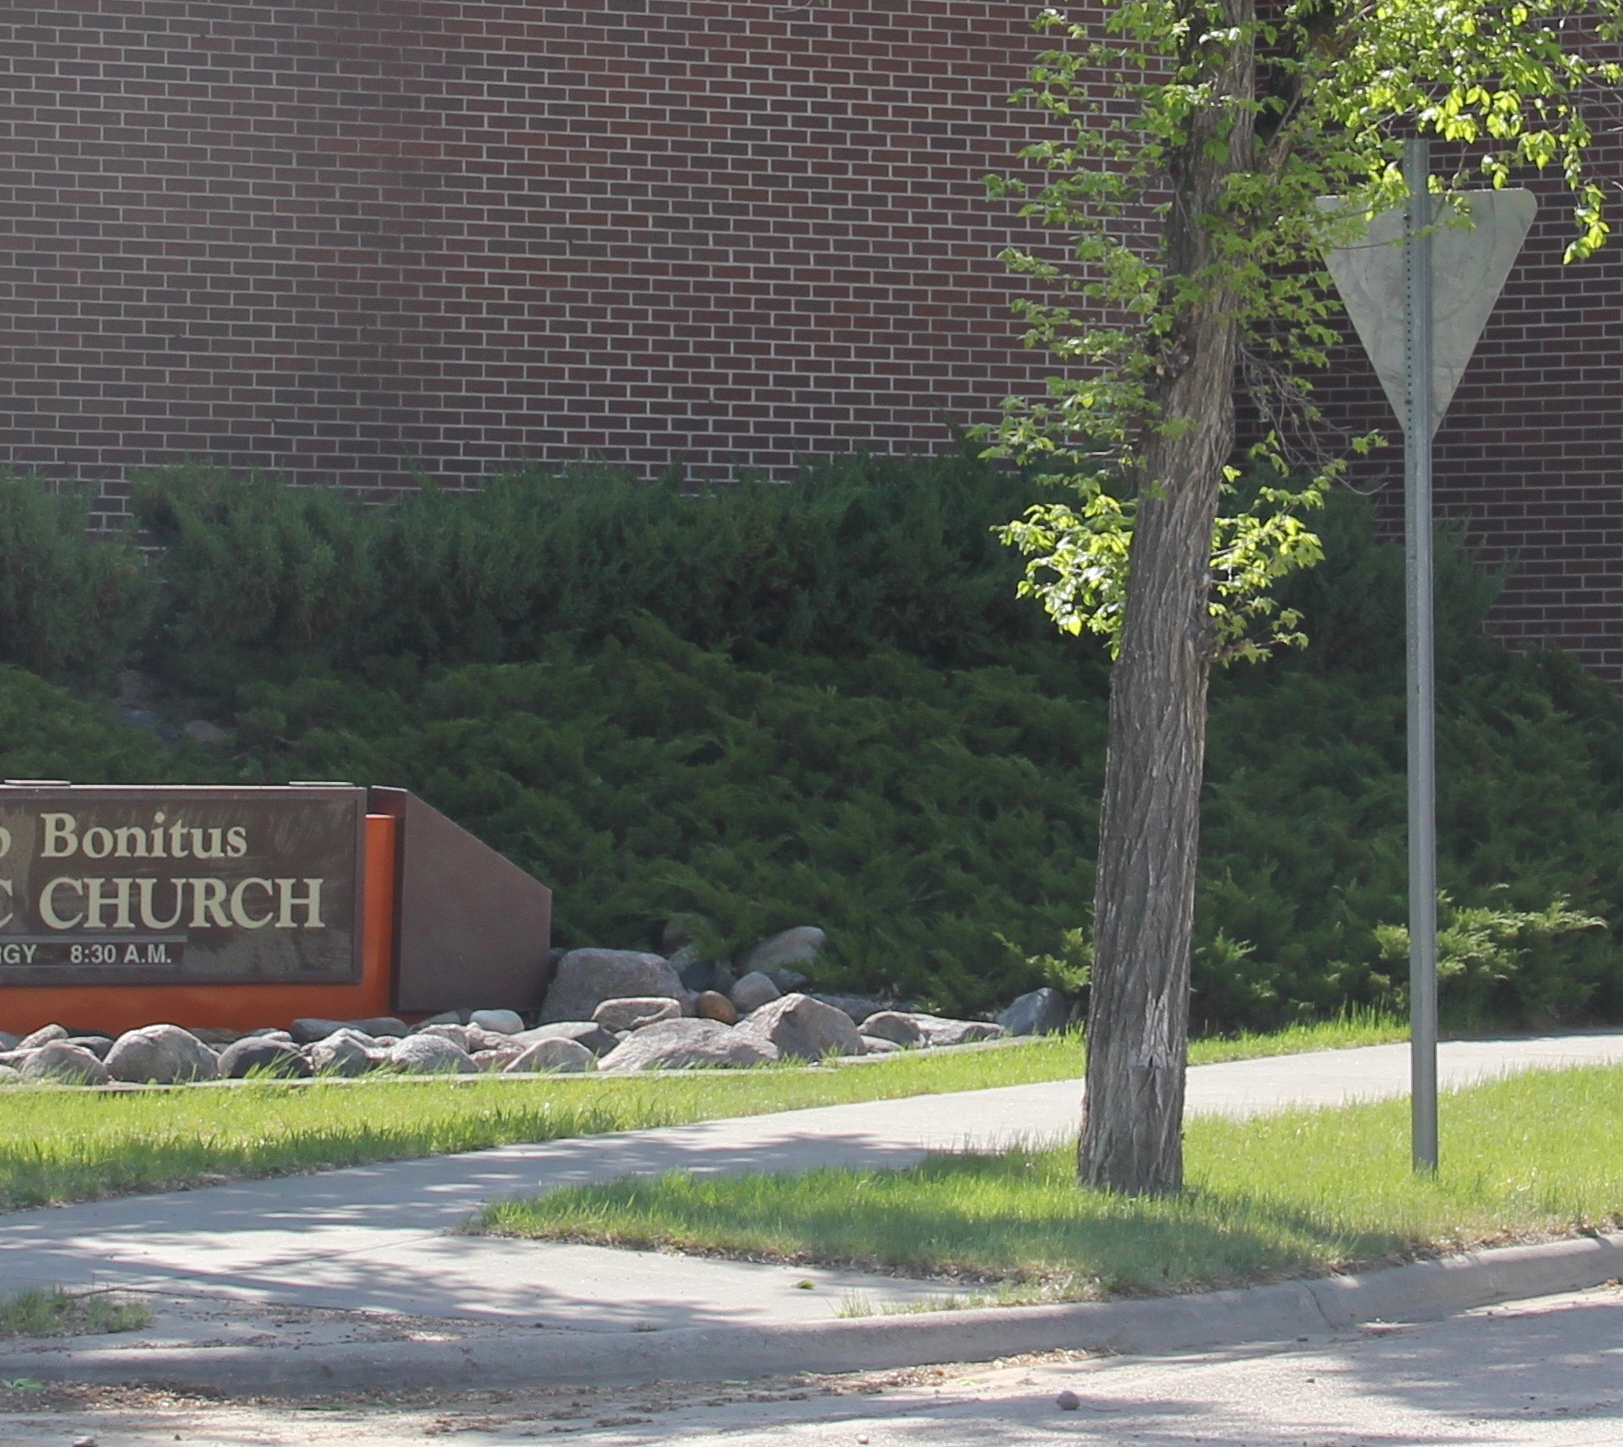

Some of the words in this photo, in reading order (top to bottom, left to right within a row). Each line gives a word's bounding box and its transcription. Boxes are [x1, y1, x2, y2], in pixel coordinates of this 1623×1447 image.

[40, 812, 248, 859] Bonitus
[39, 877, 325, 929] CHURCH
[69, 944, 117, 965] 8:30
[123, 944, 173, 965] A.M.
